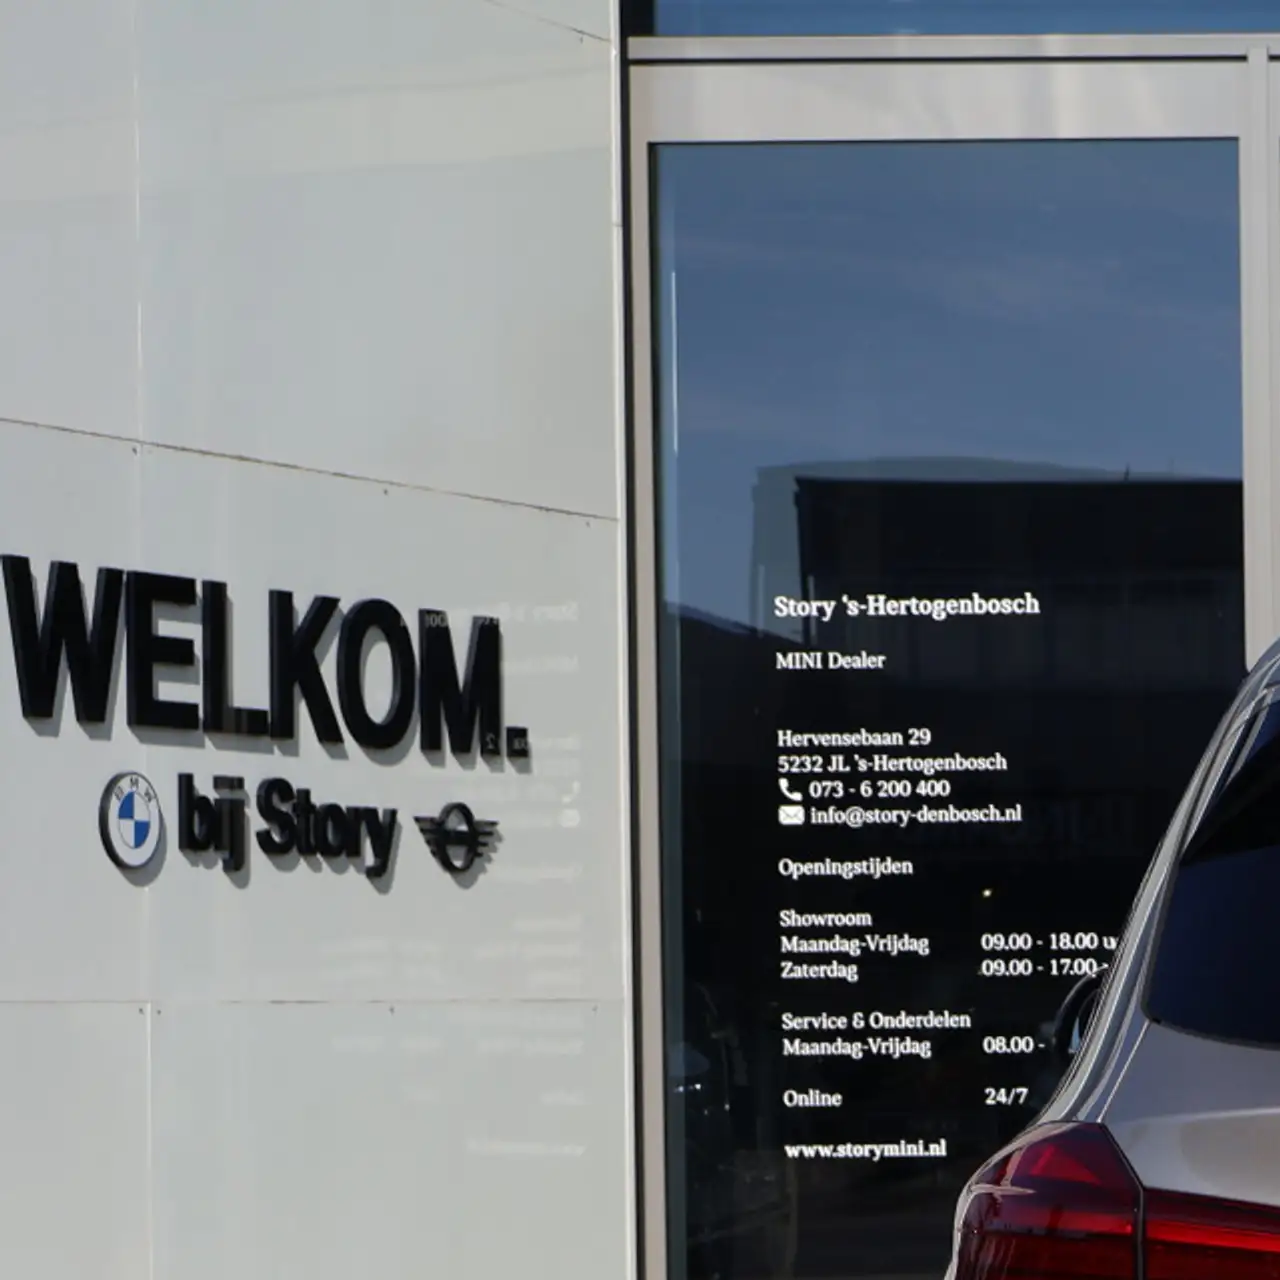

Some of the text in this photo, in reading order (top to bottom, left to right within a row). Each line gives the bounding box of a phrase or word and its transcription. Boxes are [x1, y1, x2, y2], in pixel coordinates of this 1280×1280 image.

[773, 591, 1041, 622] Story 's-Hertogenbosch
[0, 553, 530, 759] WELKOM.
[775, 650, 887, 670] MINI Dealer
[777, 727, 932, 747] Hervensebaan 29
[778, 751, 1008, 776] 5232 JL 's-Hertogenbosch
[808, 780, 844, 799] 073
[859, 780, 873, 798] 6
[876, 779, 912, 798] 200
[915, 779, 951, 797] 400
[177, 772, 245, 872] bij
[256, 777, 398, 878] Story
[810, 803, 1022, 828] info@story-denbosch.nl
[778, 856, 914, 880] Openingstijden
[779, 909, 873, 928] Showroom
[780, 933, 930, 957] Maandag-Vrijdag
[980, 932, 1033, 951] 09.00
[1050, 931, 1099, 950] 18.00
[780, 959, 859, 983] Zaterdag
[981, 958, 1033, 977] 09.00
[1050, 957, 1099, 977] 17.00
[781, 1009, 972, 1031] Service & Onderdelen
[782, 1036, 932, 1060] Maandag-Vrijdag
[982, 1035, 1035, 1054] 08.00
[783, 1087, 1029, 1108] Online 24/7
[784, 1138, 947, 1162] www.storymini.nl
